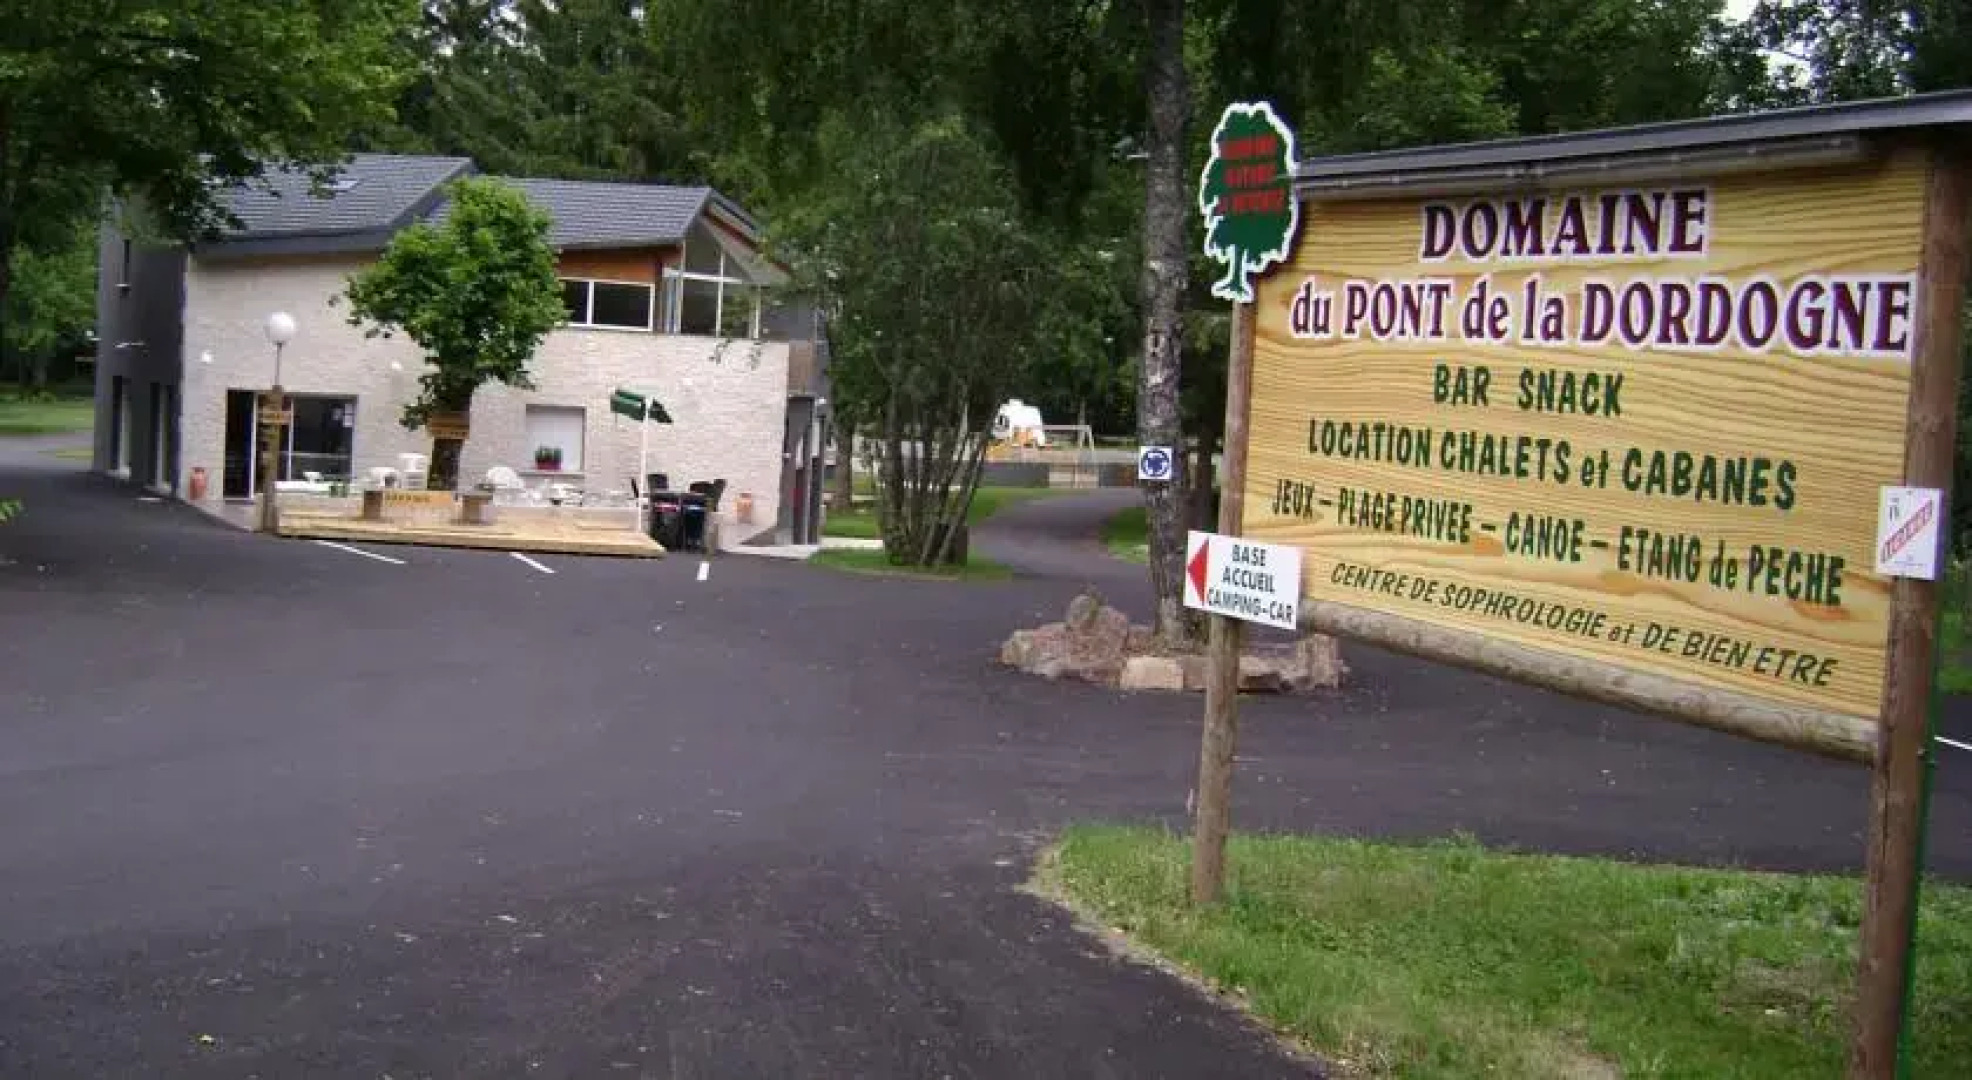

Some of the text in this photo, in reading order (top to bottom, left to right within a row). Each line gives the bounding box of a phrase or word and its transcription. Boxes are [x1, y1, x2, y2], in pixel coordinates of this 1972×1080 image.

[1421, 188, 1707, 259] DOMAINE
[1292, 279, 1911, 351] du PONT de la DORDOGNE
[1434, 363, 1624, 417] BAR SNACK
[1308, 418, 1797, 510] LOCATION CHALETS et CABANES
[1232, 544, 1266, 567] BASE
[1272, 478, 1315, 520] JEUX
[1337, 487, 1397, 532] PLAGE
[1400, 494, 1473, 544] PRIVEE
[1505, 510, 1585, 562] CANOE
[1617, 525, 1701, 583] ETANG
[1708, 539, 1739, 590] de
[1748, 543, 1845, 607] PECHE
[1206, 586, 1293, 624] CAMPING-CAR
[1222, 565, 1276, 595] ACCUEIL
[1330, 562, 1839, 686] CENTRE DE SOPHROLOGIE et DE BIEN ETRE
